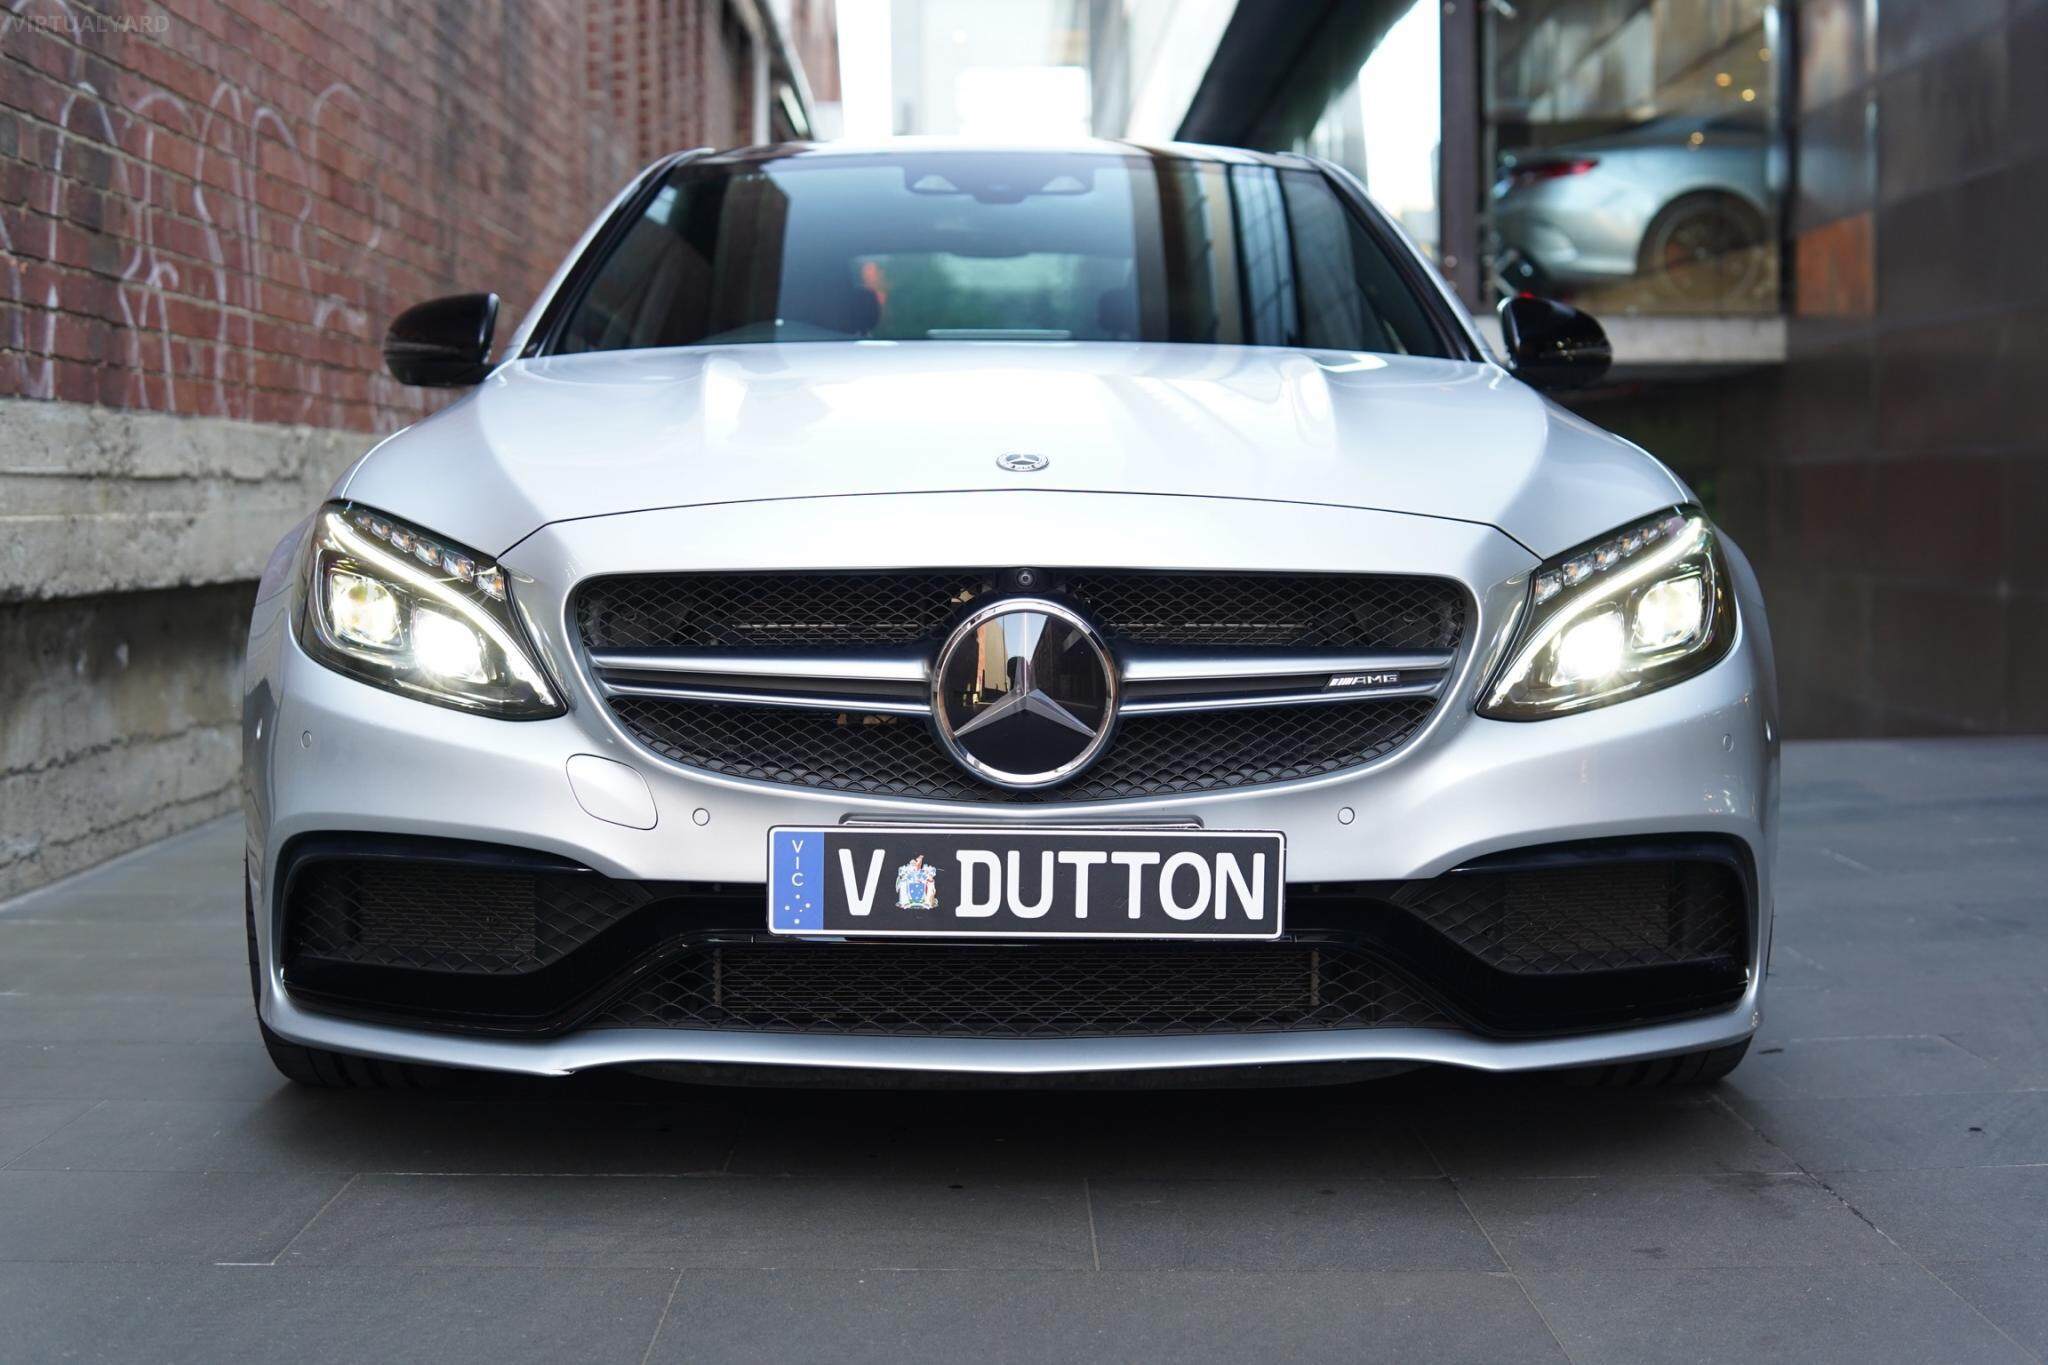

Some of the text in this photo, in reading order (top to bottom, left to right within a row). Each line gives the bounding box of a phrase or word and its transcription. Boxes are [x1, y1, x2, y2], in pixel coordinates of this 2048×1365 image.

[1350, 674, 1398, 685] AMG
[791, 839, 804, 887] VIC
[838, 848, 1266, 920] V DUTTON
